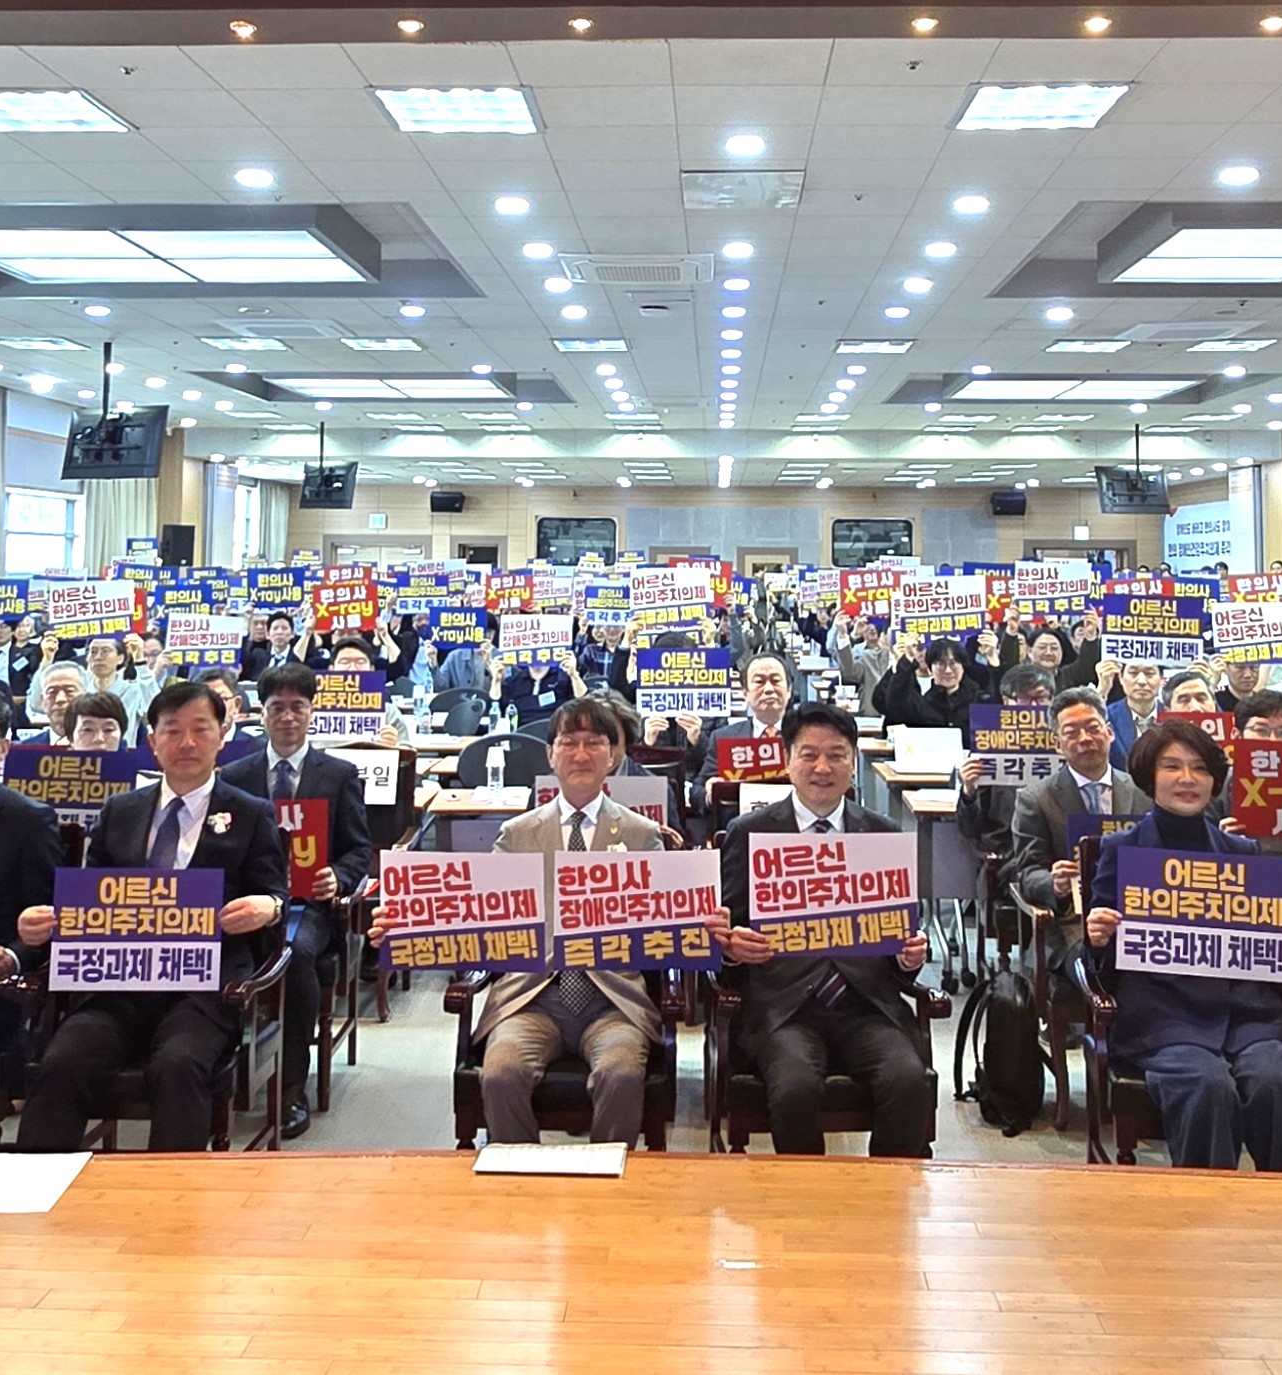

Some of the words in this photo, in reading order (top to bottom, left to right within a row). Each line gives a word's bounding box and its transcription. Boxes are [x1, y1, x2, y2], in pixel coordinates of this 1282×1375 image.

[632, 573, 675, 591] 어르신
[1018, 567, 1059, 581] 한의사
[52, 585, 97, 603] 어르신
[165, 590, 202, 604] 한의사
[320, 585, 367, 602] 한의사
[487, 587, 530, 599] X-ray
[633, 585, 707, 606] 한의주치의제
[903, 580, 949, 597] 어르신
[1174, 583, 1210, 597] 한의사
[53, 597, 130, 619] 한의주치의제
[315, 601, 374, 618] X-ray
[903, 594, 982, 613] 한의주치의제
[1130, 599, 1177, 616] 어르신
[170, 619, 210, 632] 한의사
[440, 612, 476, 627] 한의사
[503, 619, 540, 634] 한의사
[1106, 614, 1200, 635] 한의주치의제
[1215, 607, 1264, 626] 어르신
[661, 652, 706, 668] 어르신
[1106, 639, 1163, 659] 국정과제
[1166, 641, 1199, 661] 채택!
[316, 674, 360, 692] 어르신
[640, 669, 727, 686] 한의주치의제
[641, 692, 694, 712] 국정과제
[697, 692, 726, 711] 채택!
[349, 715, 380, 736] 채택!
[39, 756, 102, 779] 어르신
[753, 841, 846, 879] 어르신
[383, 861, 472, 896] 어르신
[558, 860, 651, 896] 한의사
[1165, 858, 1245, 892] 어르신
[99, 877, 177, 905] 어르신
[755, 868, 910, 912] 한의주치의제
[384, 888, 537, 929] 한의주치의제
[559, 886, 717, 929] 장애인주치의제
[60, 907, 215, 935] 한의주치의제
[760, 916, 854, 952] 국정과제
[857, 909, 910, 943] 채택!
[390, 934, 481, 967] 국정과제
[484, 929, 538, 960] 채택!
[1124, 928, 1221, 968] 국정과제
[1228, 935, 1282, 973] 채택!
[57, 948, 152, 982] 국정과제
[158, 948, 213, 982] 채택!
